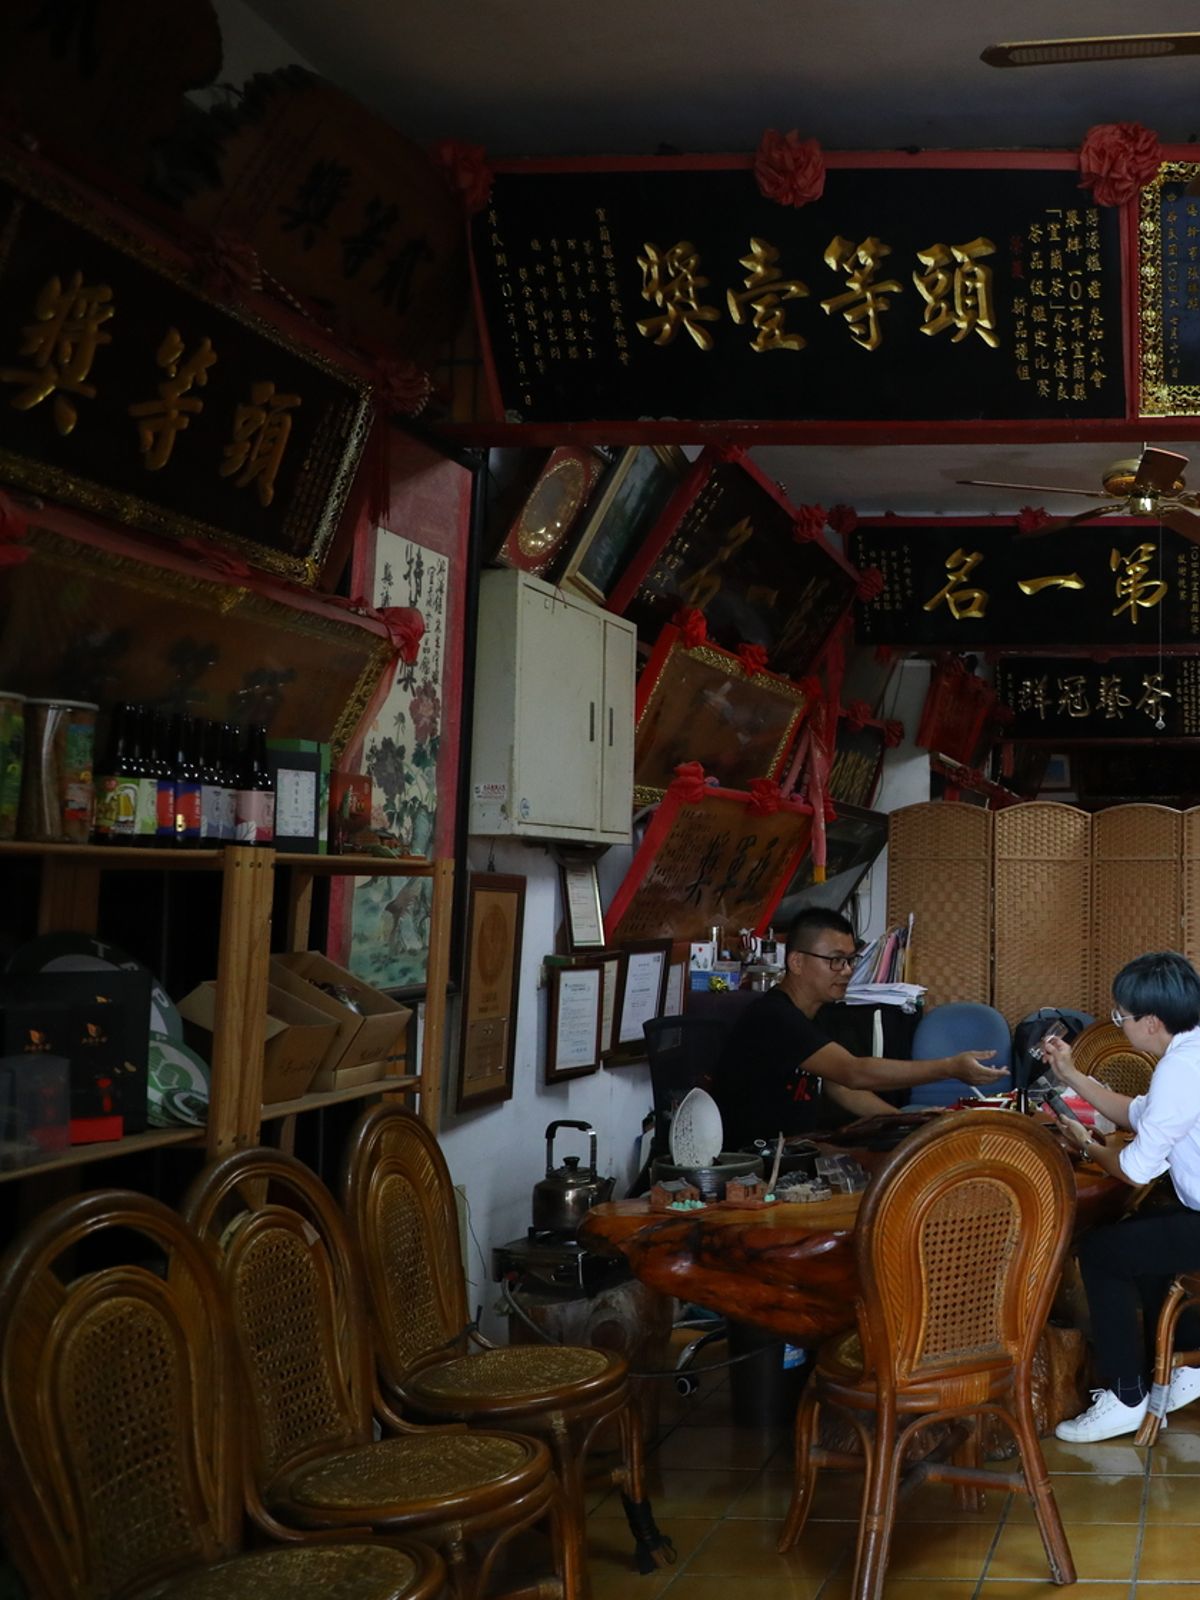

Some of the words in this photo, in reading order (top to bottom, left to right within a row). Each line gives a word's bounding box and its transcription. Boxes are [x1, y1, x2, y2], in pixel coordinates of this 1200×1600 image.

[635, 235, 1001, 352] 頭等壹獎
[0, 270, 303, 508] 頭等獎
[923, 543, 1168, 624] 第一名
